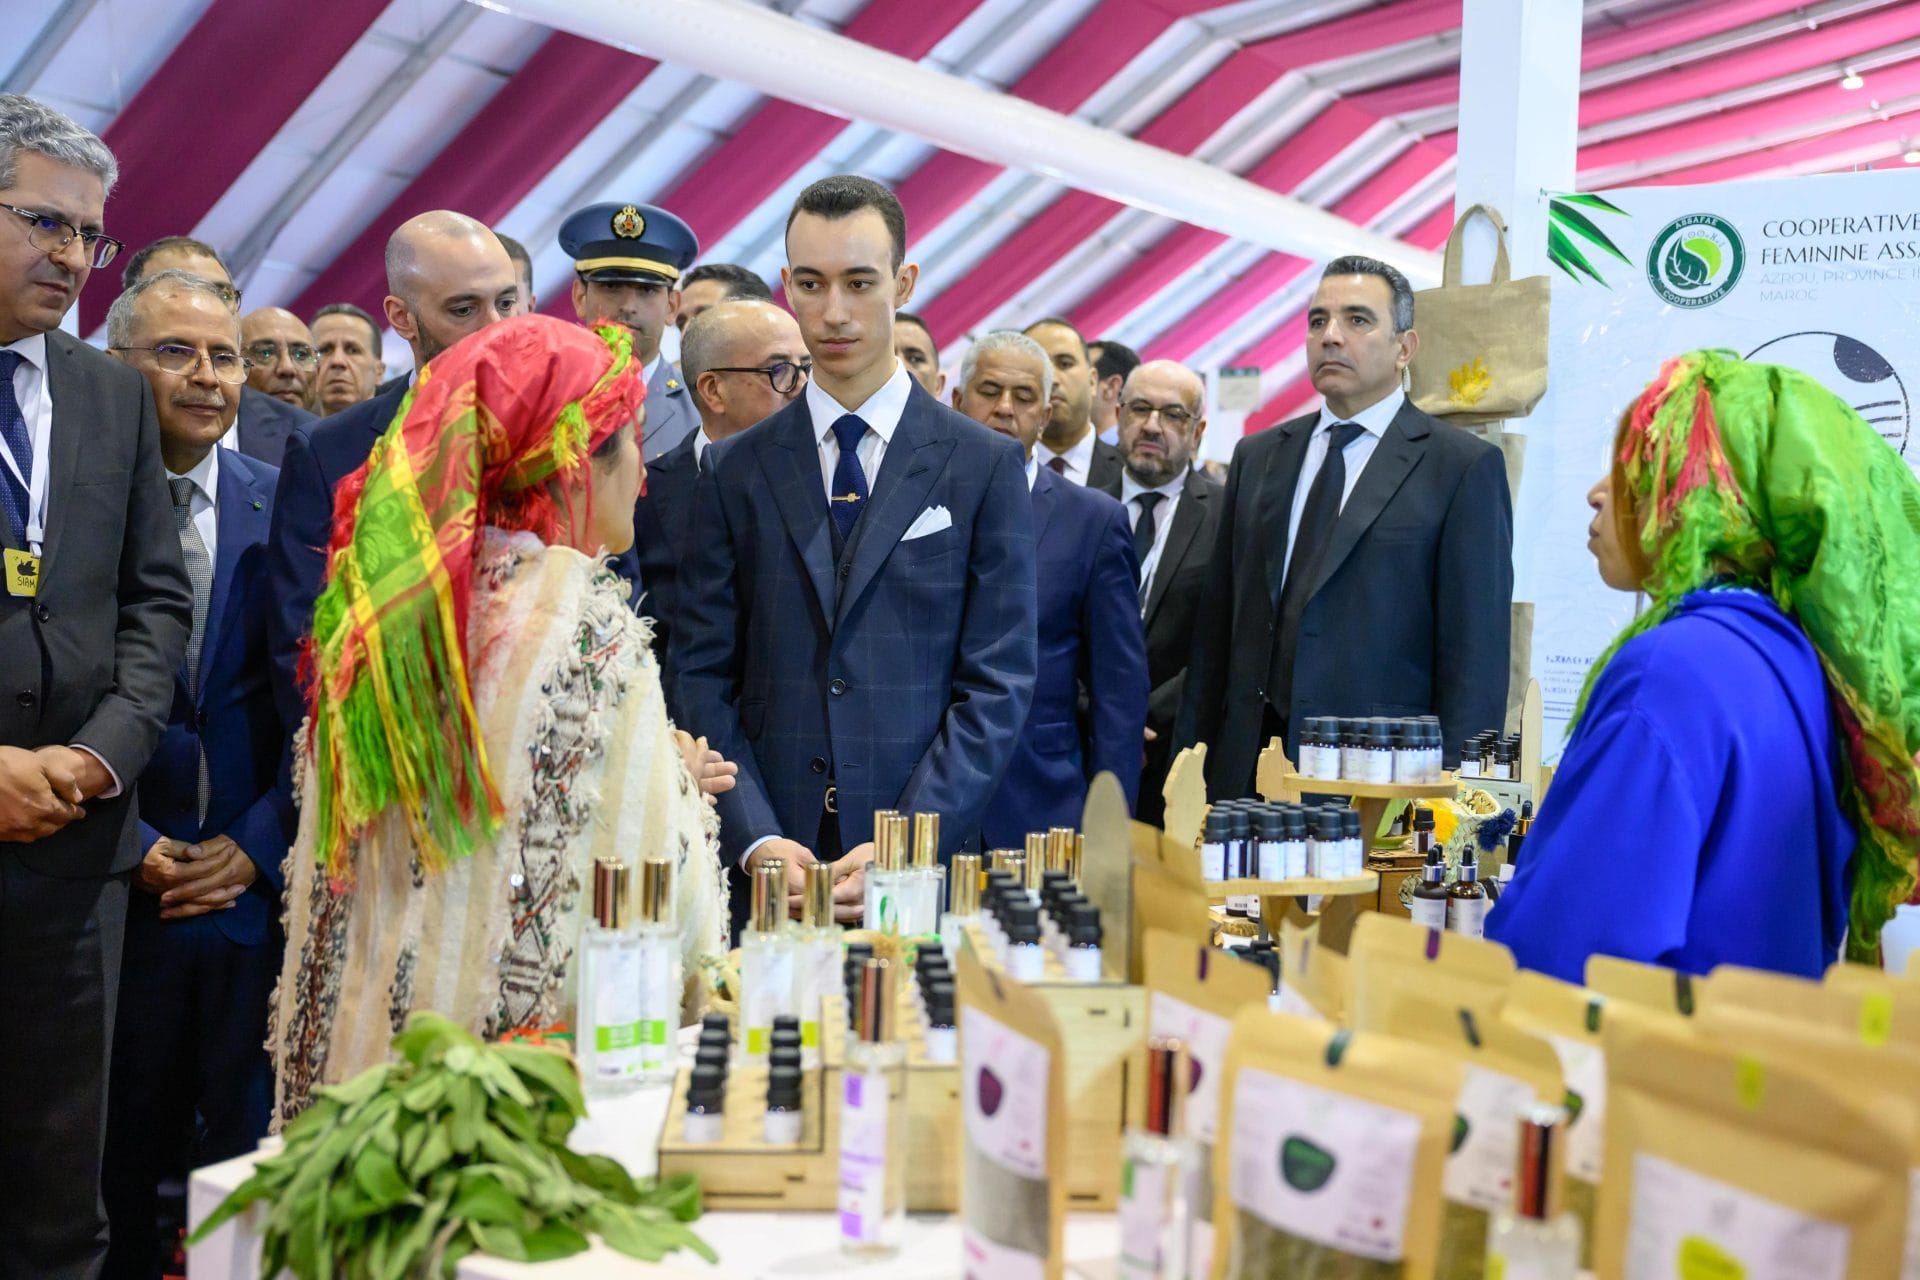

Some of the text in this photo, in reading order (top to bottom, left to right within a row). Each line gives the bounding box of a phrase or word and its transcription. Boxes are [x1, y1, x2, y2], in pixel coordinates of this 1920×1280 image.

[1762, 213, 1920, 239] COOPERATIVE
[1761, 241, 1920, 265] FEMININE ASS
[1824, 267, 1905, 282] PROVINCE
[1662, 287, 1725, 306] COOPERATIVE
[1760, 289, 1817, 302] MAROC
[17, 576, 36, 588] SIAM
